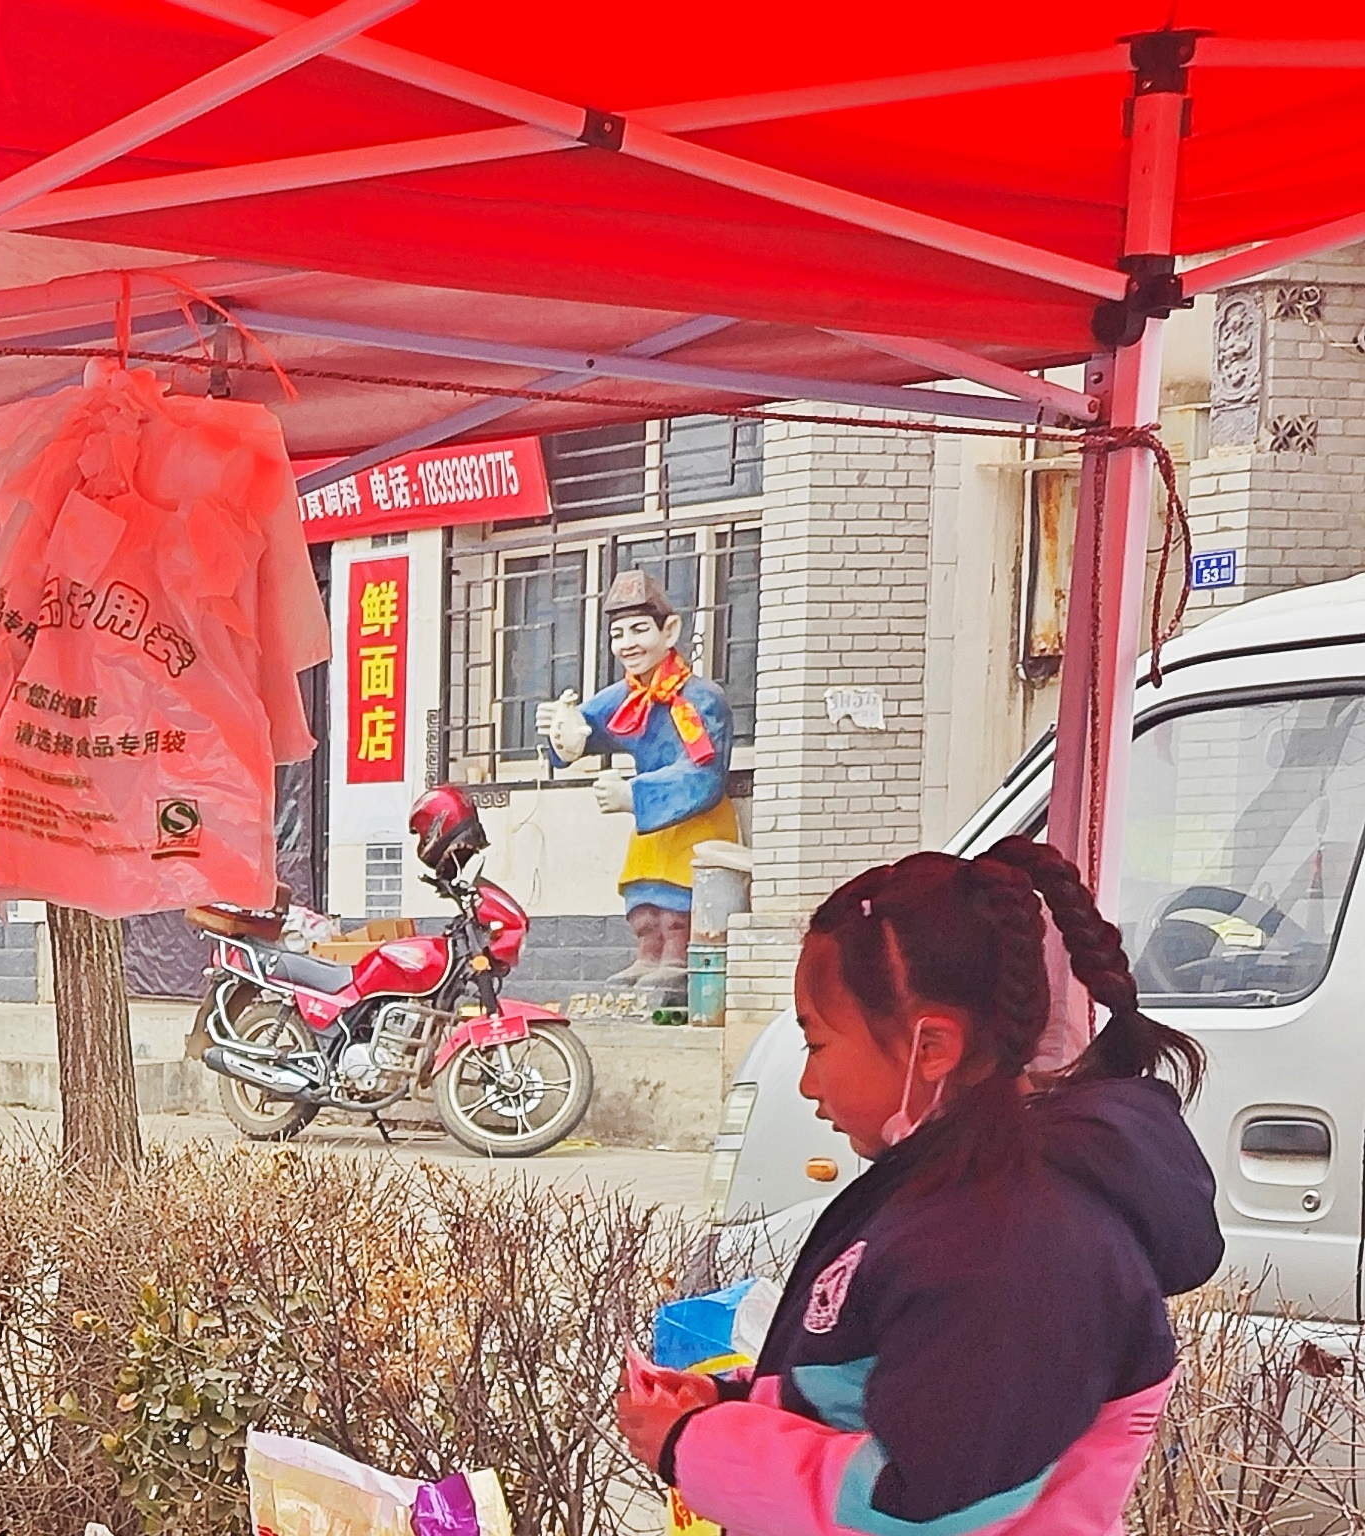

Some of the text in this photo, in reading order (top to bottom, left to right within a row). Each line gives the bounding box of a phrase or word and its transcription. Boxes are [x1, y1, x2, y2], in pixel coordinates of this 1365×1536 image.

[357, 579, 399, 762] 鲜面店
[16, 729, 187, 761] 请选择食品专用袋
